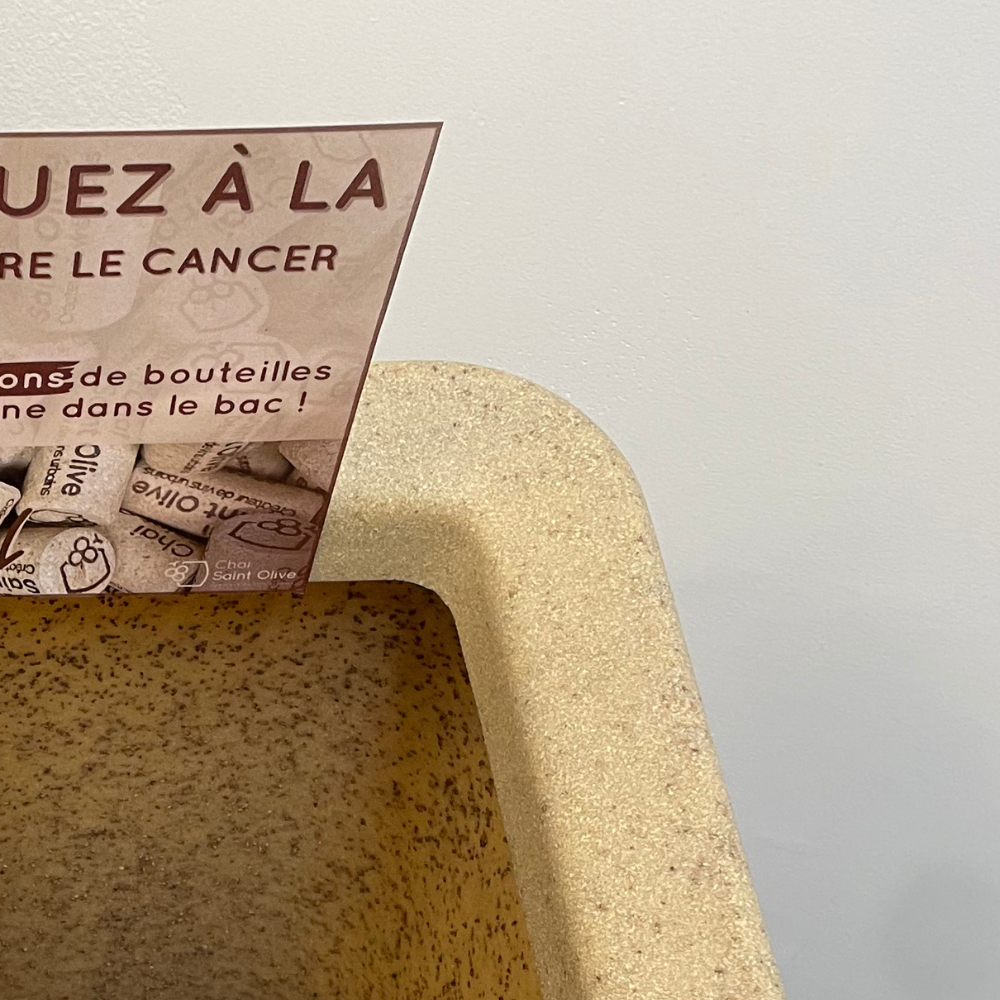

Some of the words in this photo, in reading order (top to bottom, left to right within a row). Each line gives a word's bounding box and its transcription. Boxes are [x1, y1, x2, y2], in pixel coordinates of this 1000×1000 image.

[201, 143, 254, 215] À
[289, 157, 389, 212] LA
[72, 249, 125, 280] LE
[142, 244, 340, 276] CANCER
[80, 364, 128, 388] de
[144, 360, 333, 386] bouteilles
[61, 397, 154, 420] dans
[169, 394, 199, 417] le
[214, 393, 284, 416] bac
[297, 391, 309, 413] !
[61, 444, 101, 498] Olive
[143, 466, 191, 488] urbains
[132, 480, 200, 514] Olive
[190, 479, 217, 496] vins
[216, 487, 236, 502] de
[235, 492, 297, 517] Créateur
[129, 524, 195, 558] Chai
[212, 569, 251, 581] Saint
[256, 568, 297, 581] Olive
[215, 559, 251, 570] Chai
